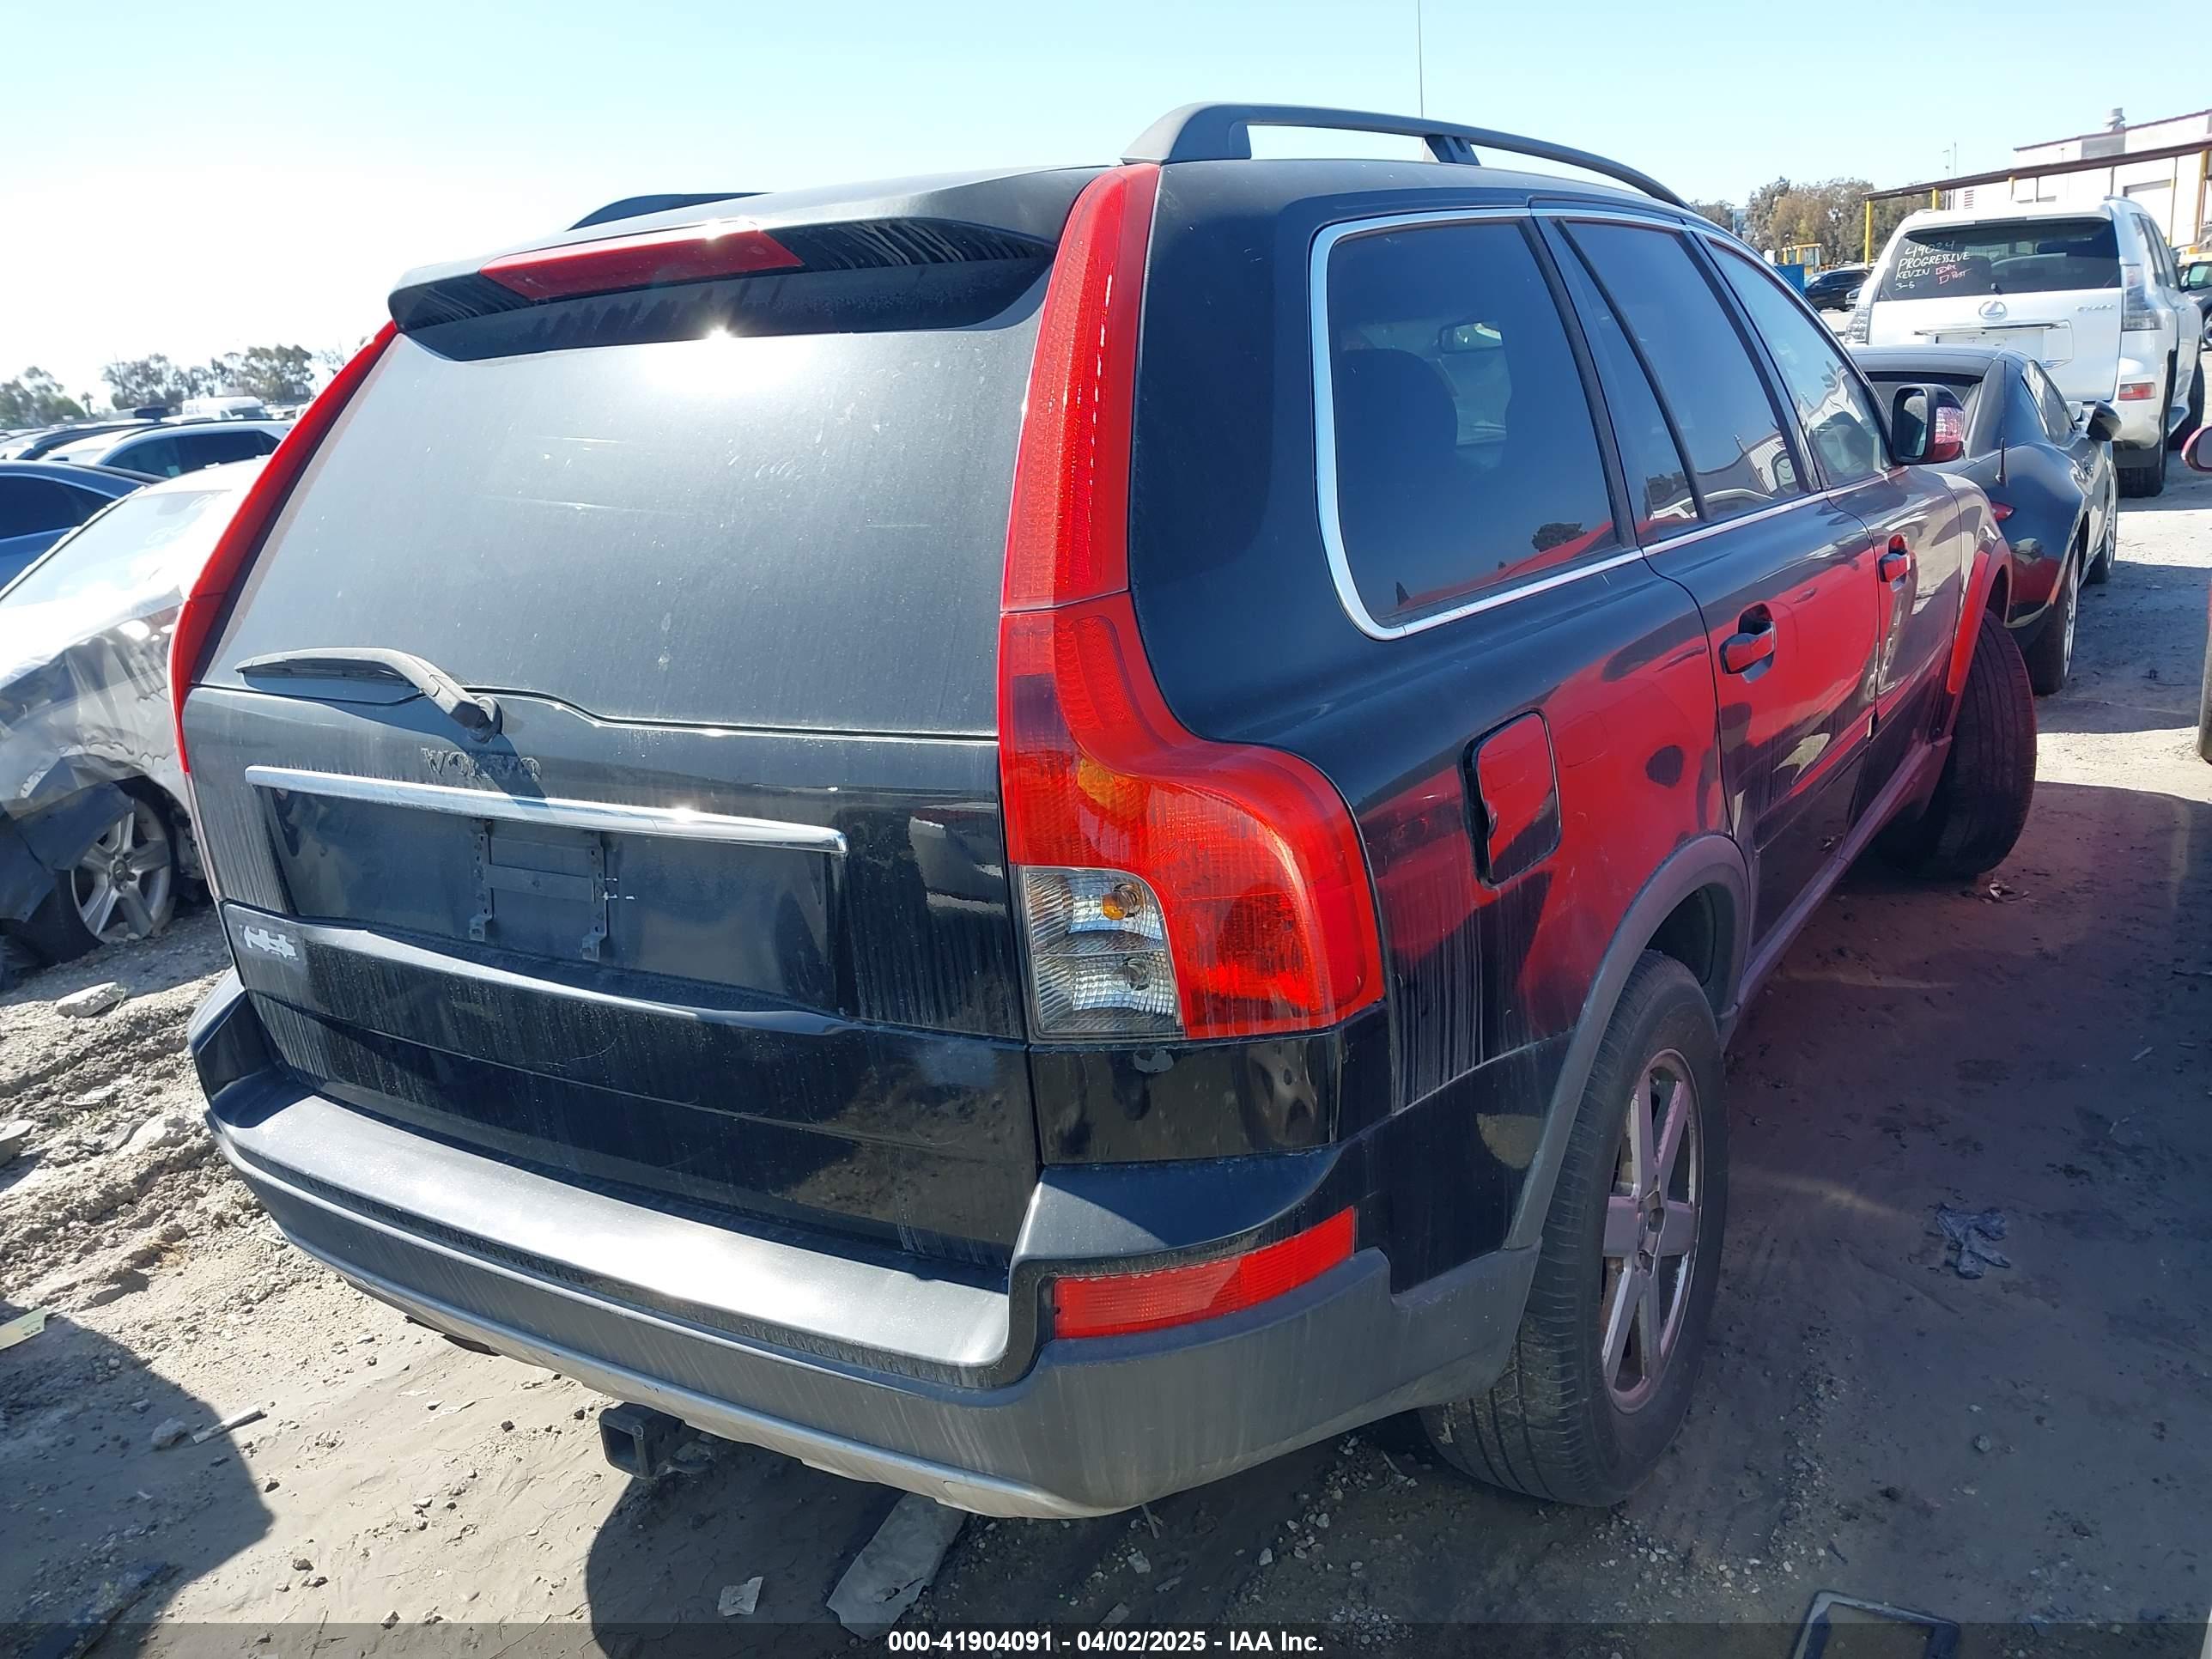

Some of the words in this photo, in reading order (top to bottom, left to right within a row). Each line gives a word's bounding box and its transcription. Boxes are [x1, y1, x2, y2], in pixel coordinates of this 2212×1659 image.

[1905, 240, 1955, 258] 49024
[1898, 252, 1971, 271] PROGRESSIVE
[1895, 267, 1930, 281] KEVIN
